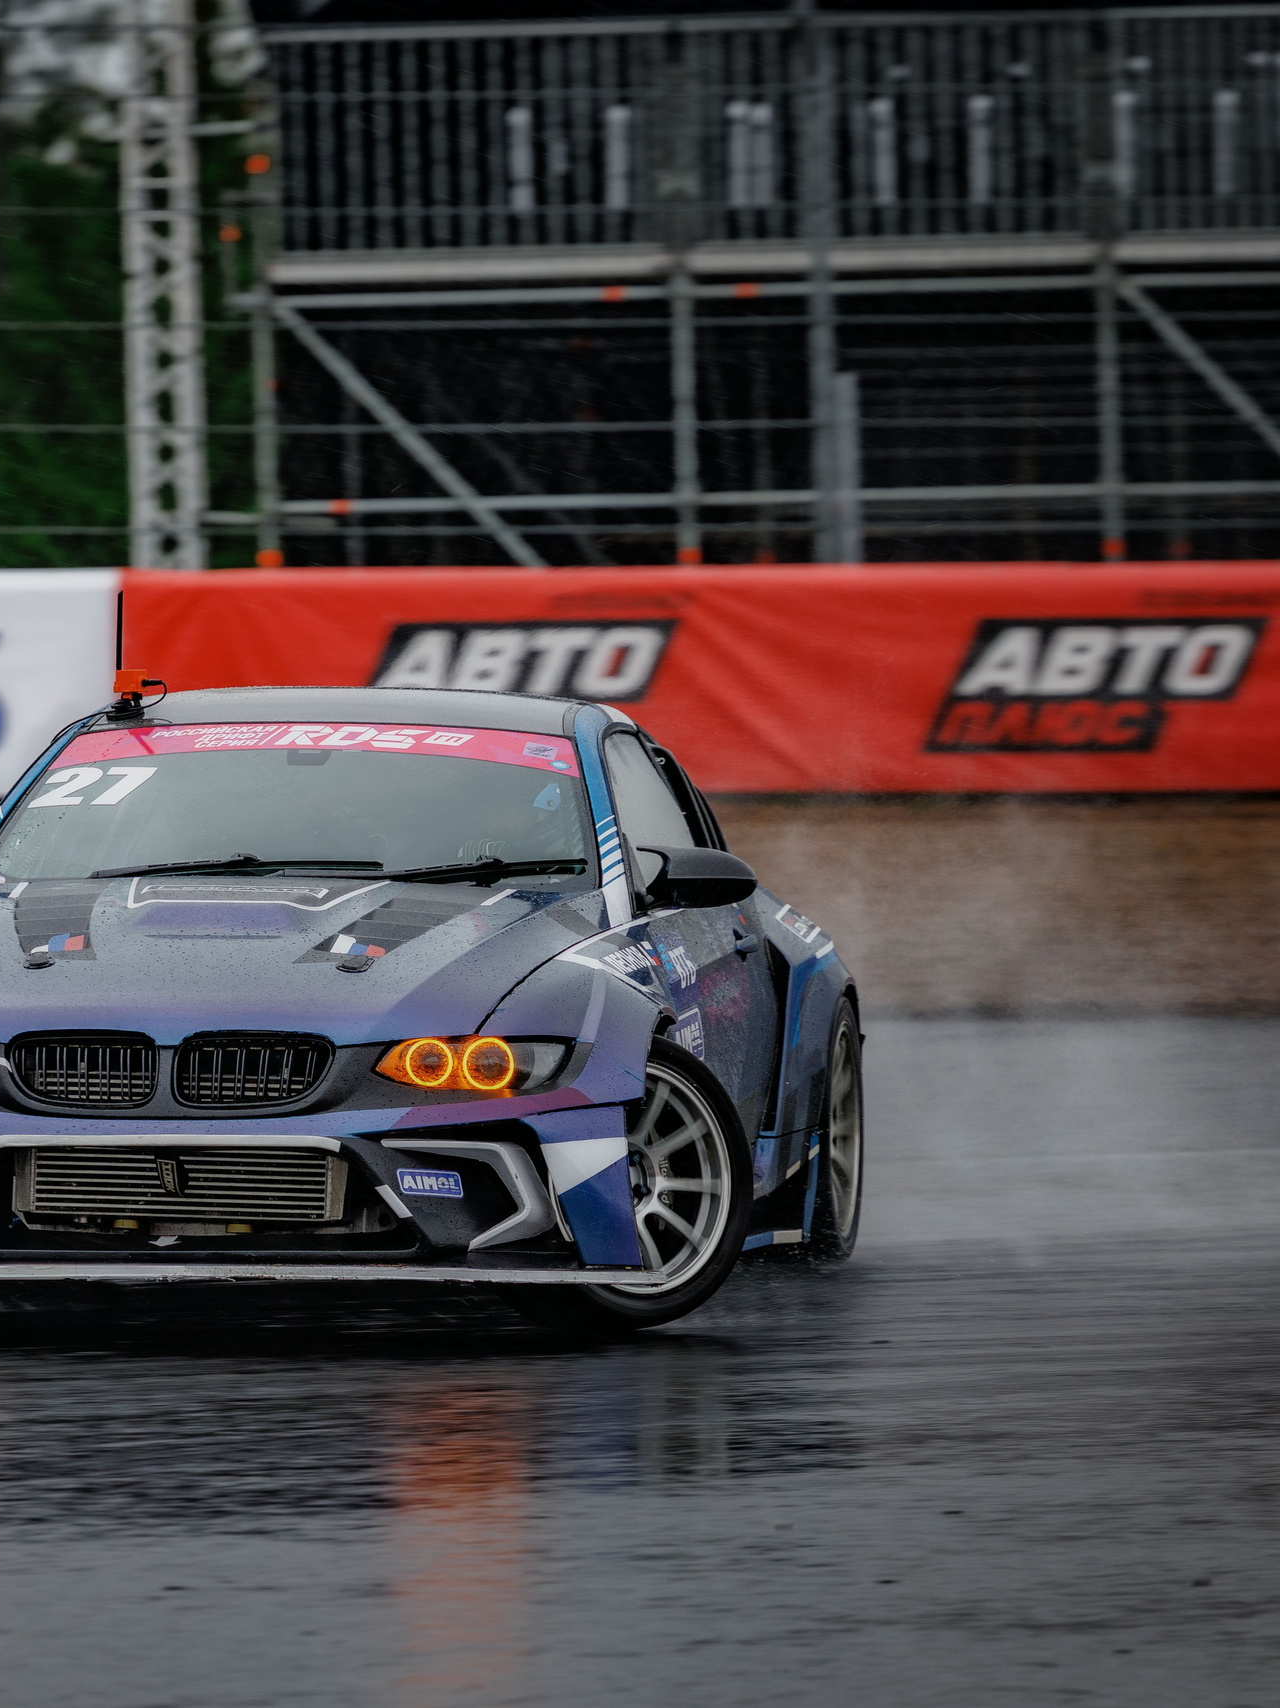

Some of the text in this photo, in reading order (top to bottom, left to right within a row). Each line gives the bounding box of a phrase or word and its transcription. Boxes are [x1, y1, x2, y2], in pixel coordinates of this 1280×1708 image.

[372, 627, 666, 698] АВТО
[954, 624, 1256, 697] АВТО
[151, 725, 279, 739] РОССИЙСКАЯ
[936, 701, 1150, 745] ПЛЮС
[193, 739, 260, 749] СЕРИЯ
[194, 733, 269, 743] ДРИФТ
[273, 725, 432, 750] RDS
[27, 766, 158, 808] 27
[403, 1175, 460, 1191] AIMOL
